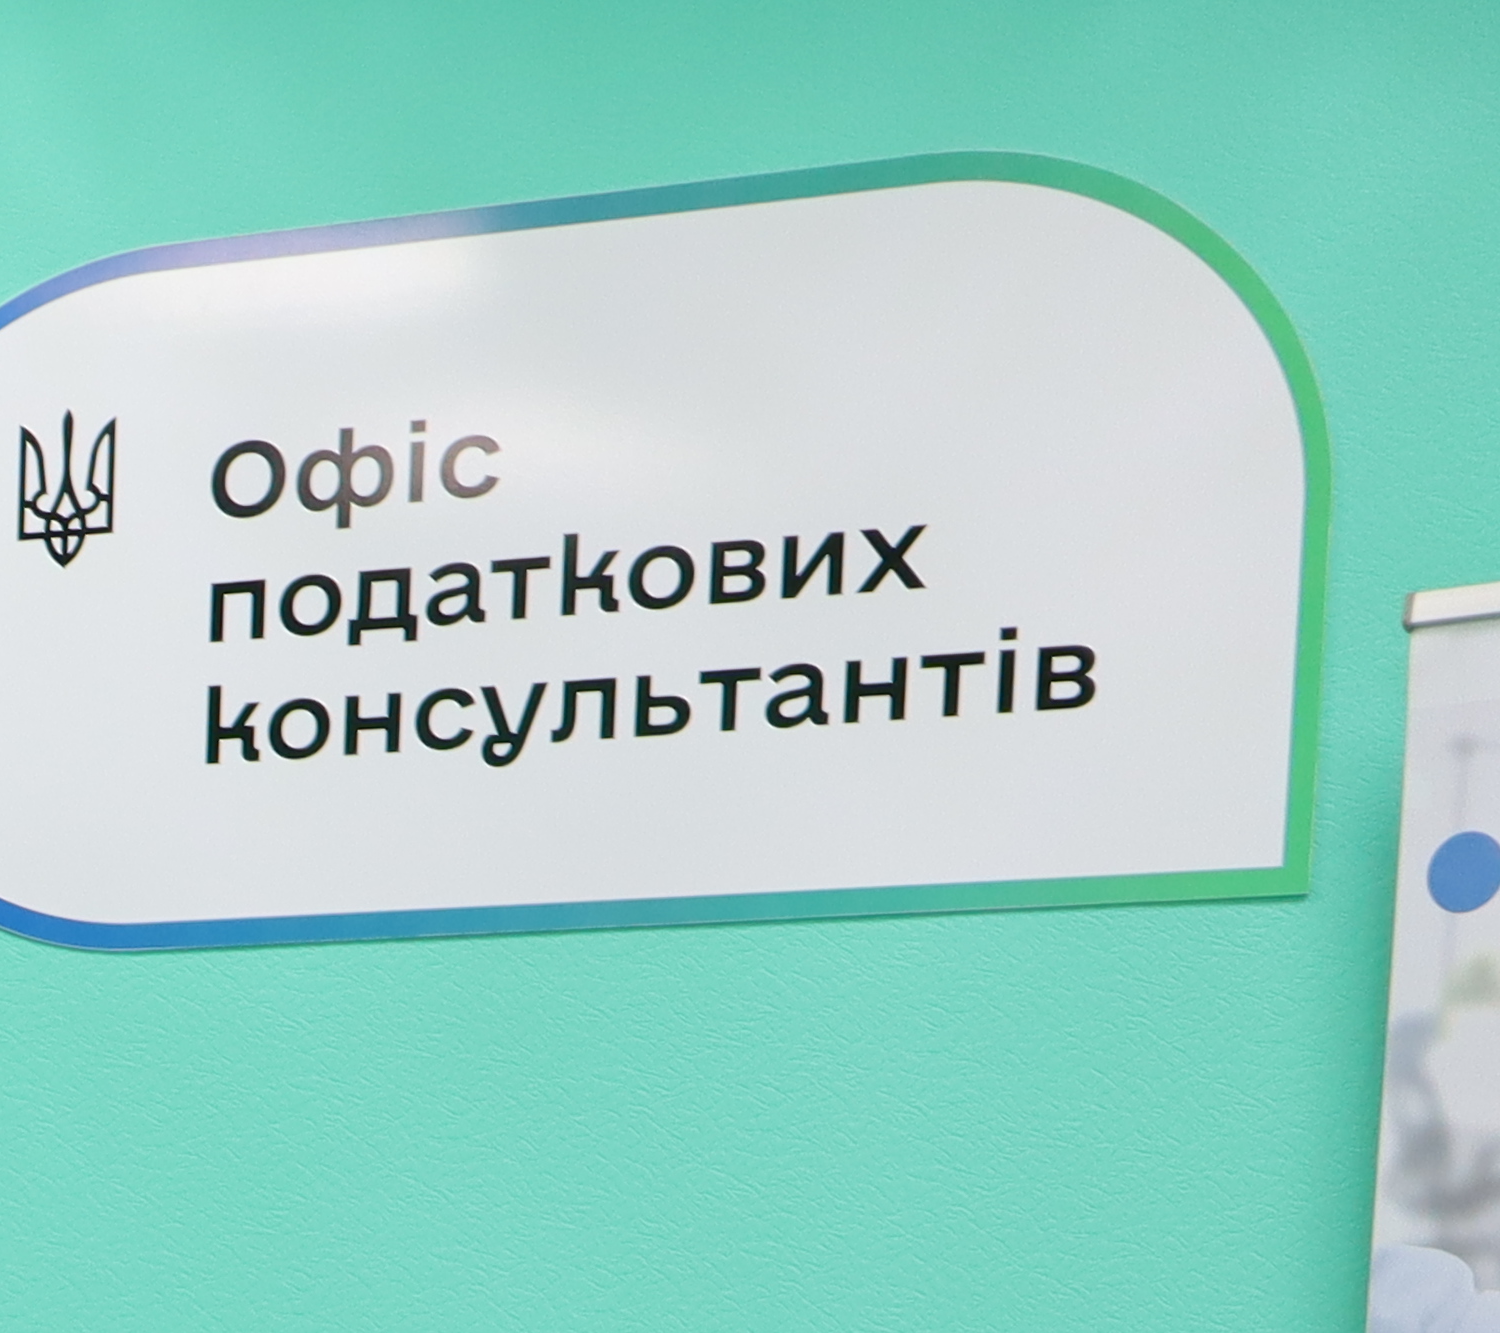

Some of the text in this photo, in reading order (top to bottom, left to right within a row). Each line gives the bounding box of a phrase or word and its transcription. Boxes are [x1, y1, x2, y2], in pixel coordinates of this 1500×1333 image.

[210, 419, 501, 530] Офіс
[209, 523, 928, 647] податкових
[204, 626, 1097, 768] консультантів
